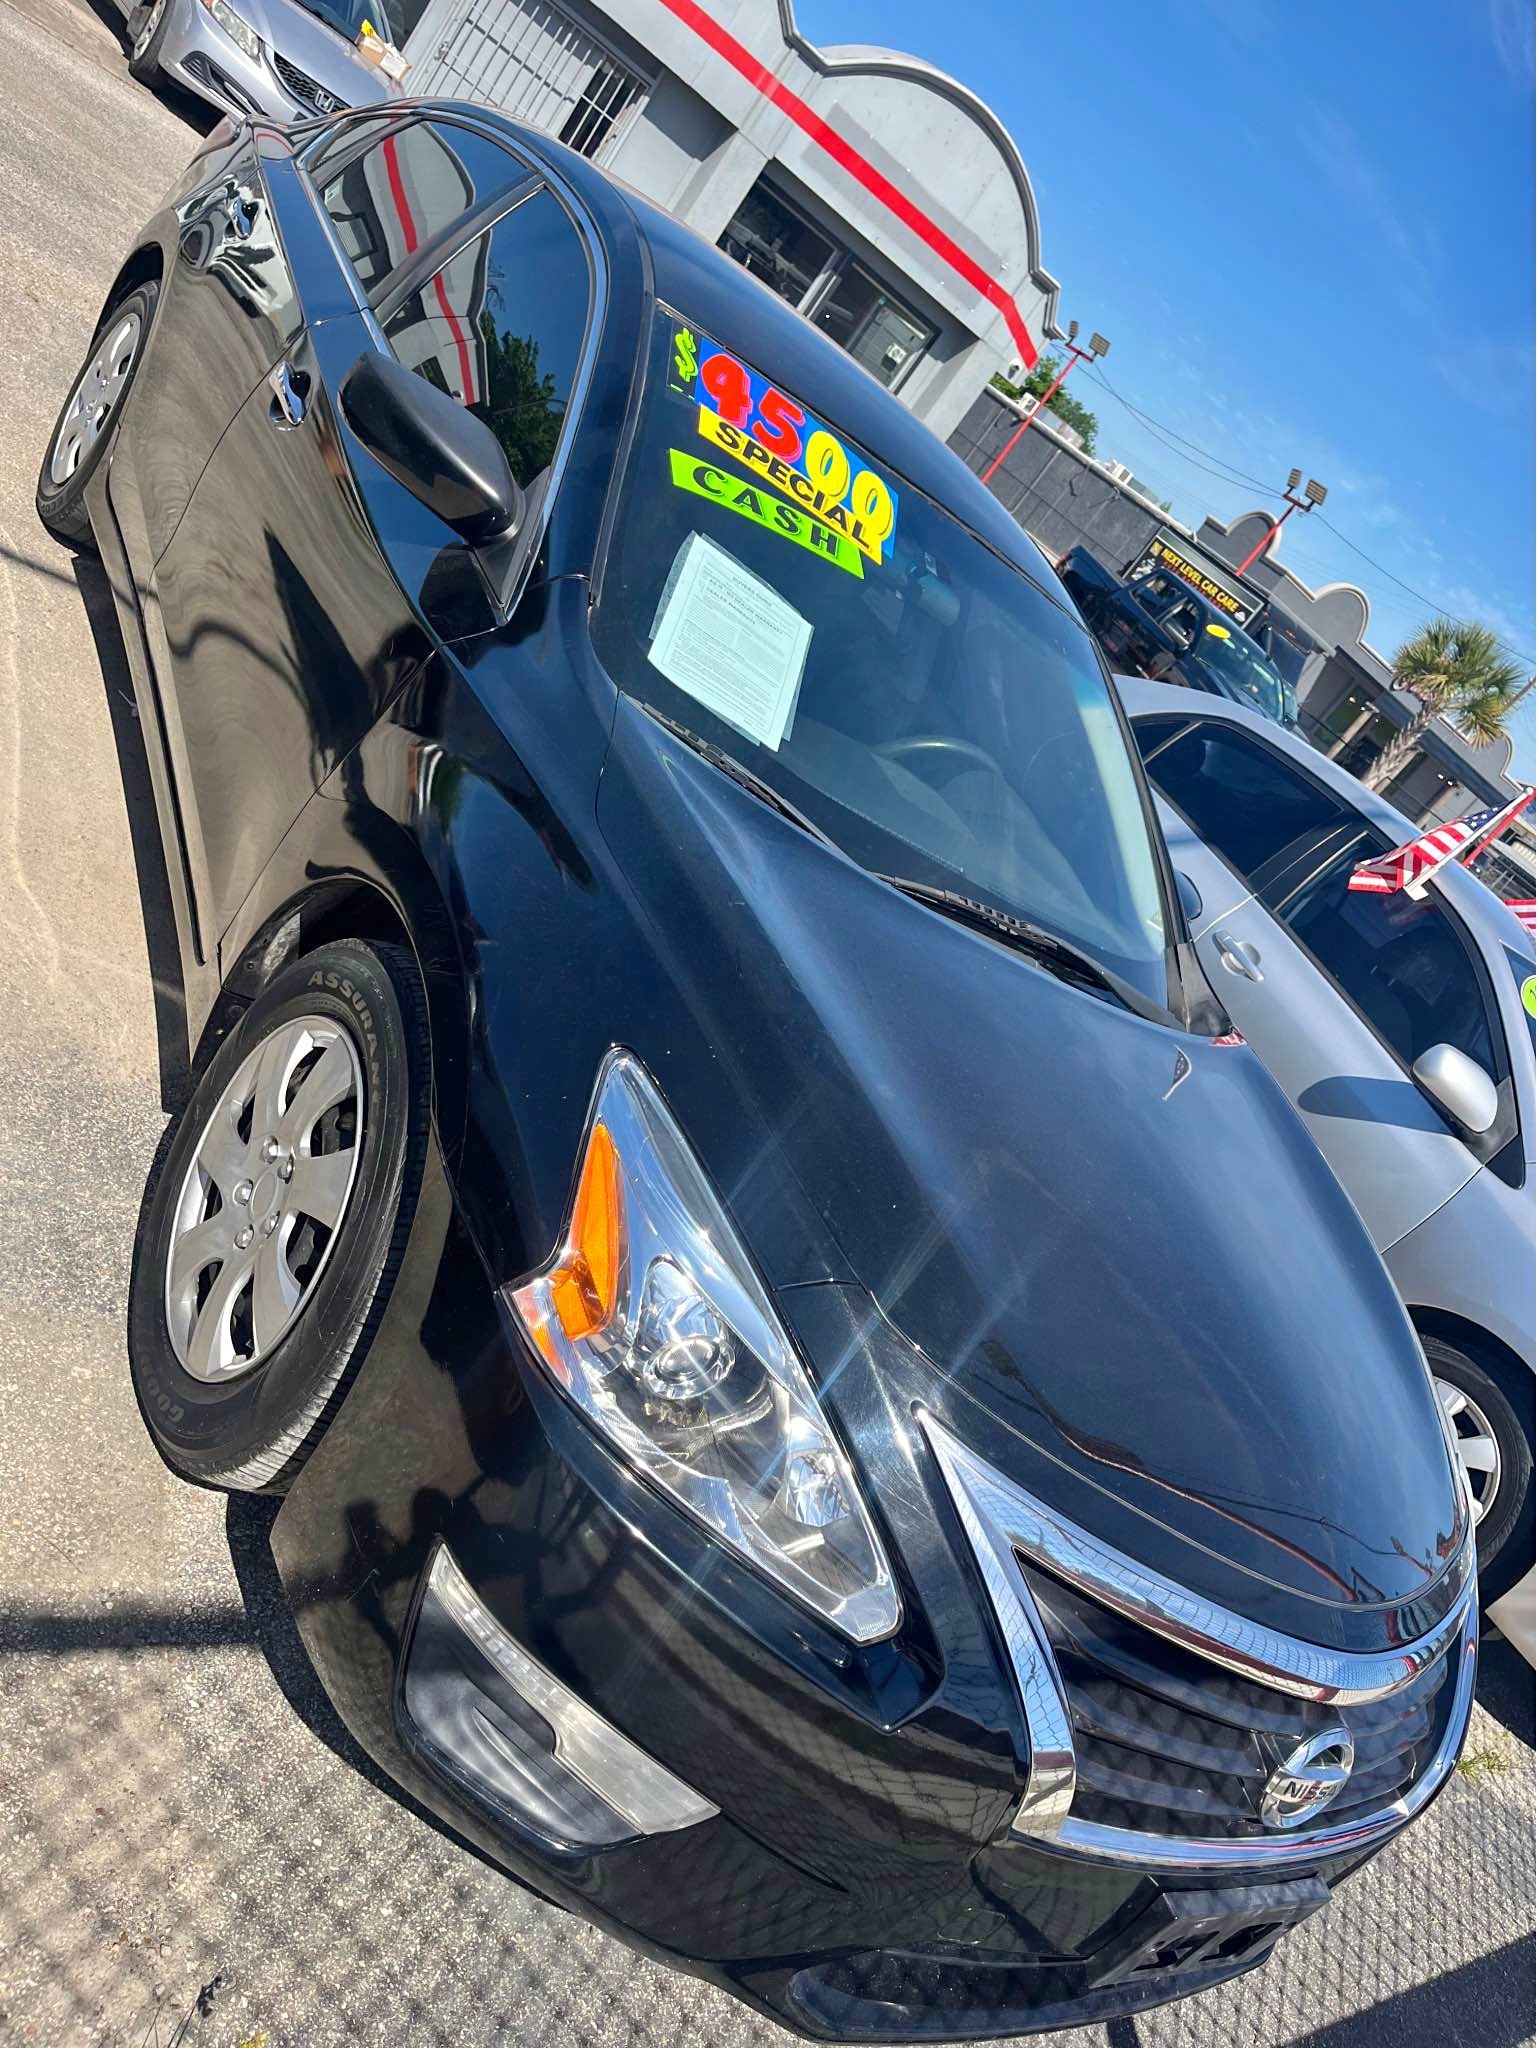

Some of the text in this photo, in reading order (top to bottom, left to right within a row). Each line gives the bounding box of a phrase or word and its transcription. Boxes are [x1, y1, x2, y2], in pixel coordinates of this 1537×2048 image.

[693, 466, 839, 558] CASH
[715, 421, 870, 549] SPECIAL
[1161, 548, 1184, 568] NEXT
[1180, 562, 1203, 584] LEVEL
[1200, 580, 1219, 598] CAR
[1215, 592, 1239, 613] CARE
[306, 969, 382, 1104] ASSURAN
